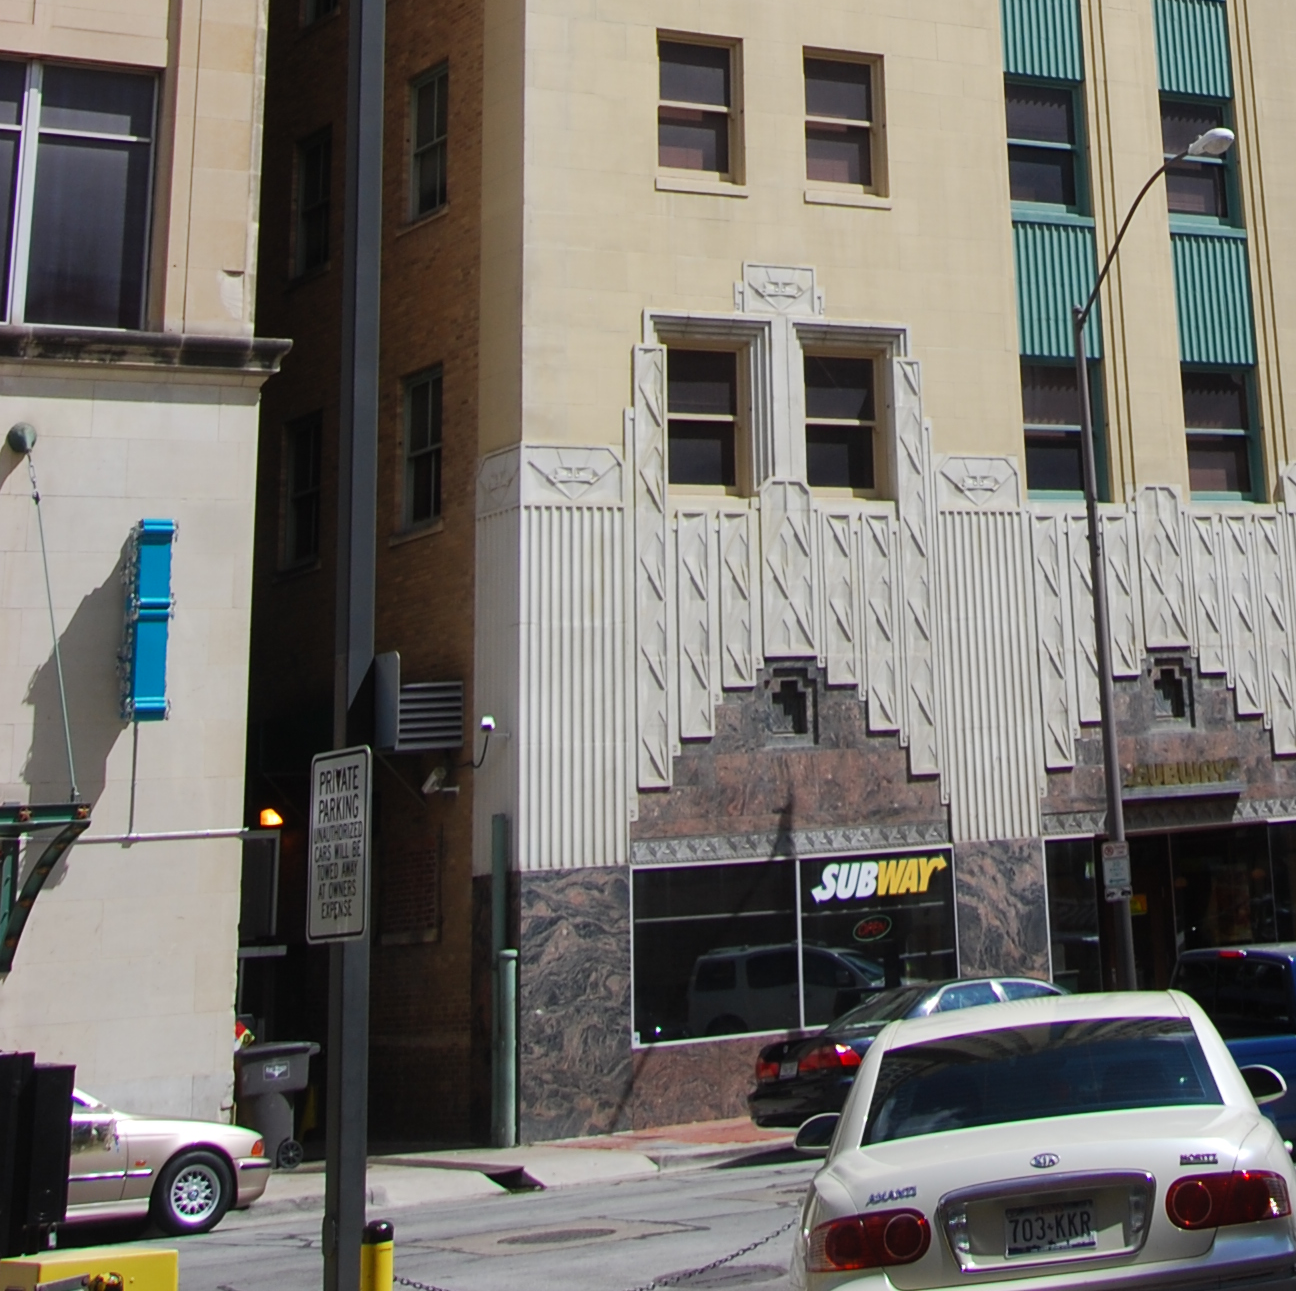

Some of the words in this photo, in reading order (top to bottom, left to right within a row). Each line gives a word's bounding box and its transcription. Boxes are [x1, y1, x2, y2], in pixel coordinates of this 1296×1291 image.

[319, 765, 360, 796] PRIVATE
[318, 794, 359, 824] PARKING
[313, 821, 363, 844] UNAUTHORIZED
[314, 844, 332, 863] CARS
[334, 841, 349, 860] WILL
[351, 840, 361, 857] BE
[317, 862, 338, 881] TOWED
[341, 860, 358, 877] AWAY
[811, 855, 947, 903] SUBWAY
[317, 884, 326, 900] AT
[328, 880, 356, 899] OWNERS
[321, 899, 353, 919] EXPENSE
